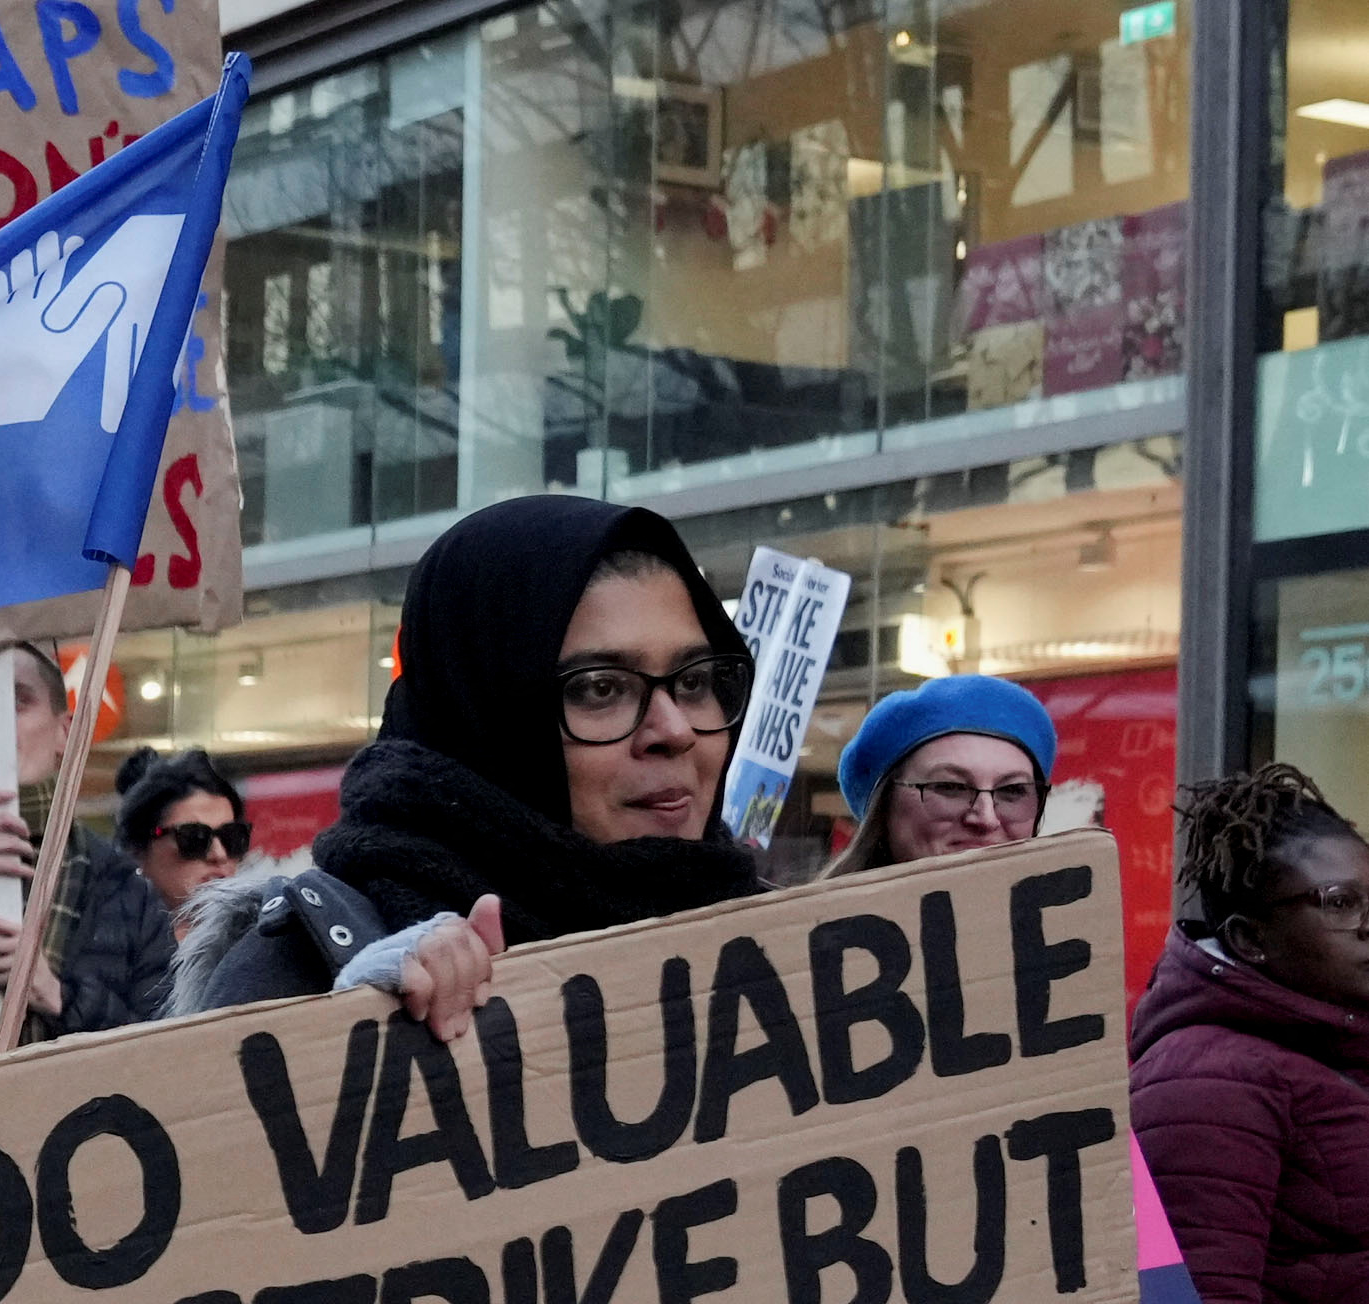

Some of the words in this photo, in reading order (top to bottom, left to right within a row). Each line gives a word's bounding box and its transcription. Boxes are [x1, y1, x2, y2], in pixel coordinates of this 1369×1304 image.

[741, 579, 824, 649] STRKE
[767, 649, 817, 708] AVE
[238, 865, 1105, 1235] VALUABLE
